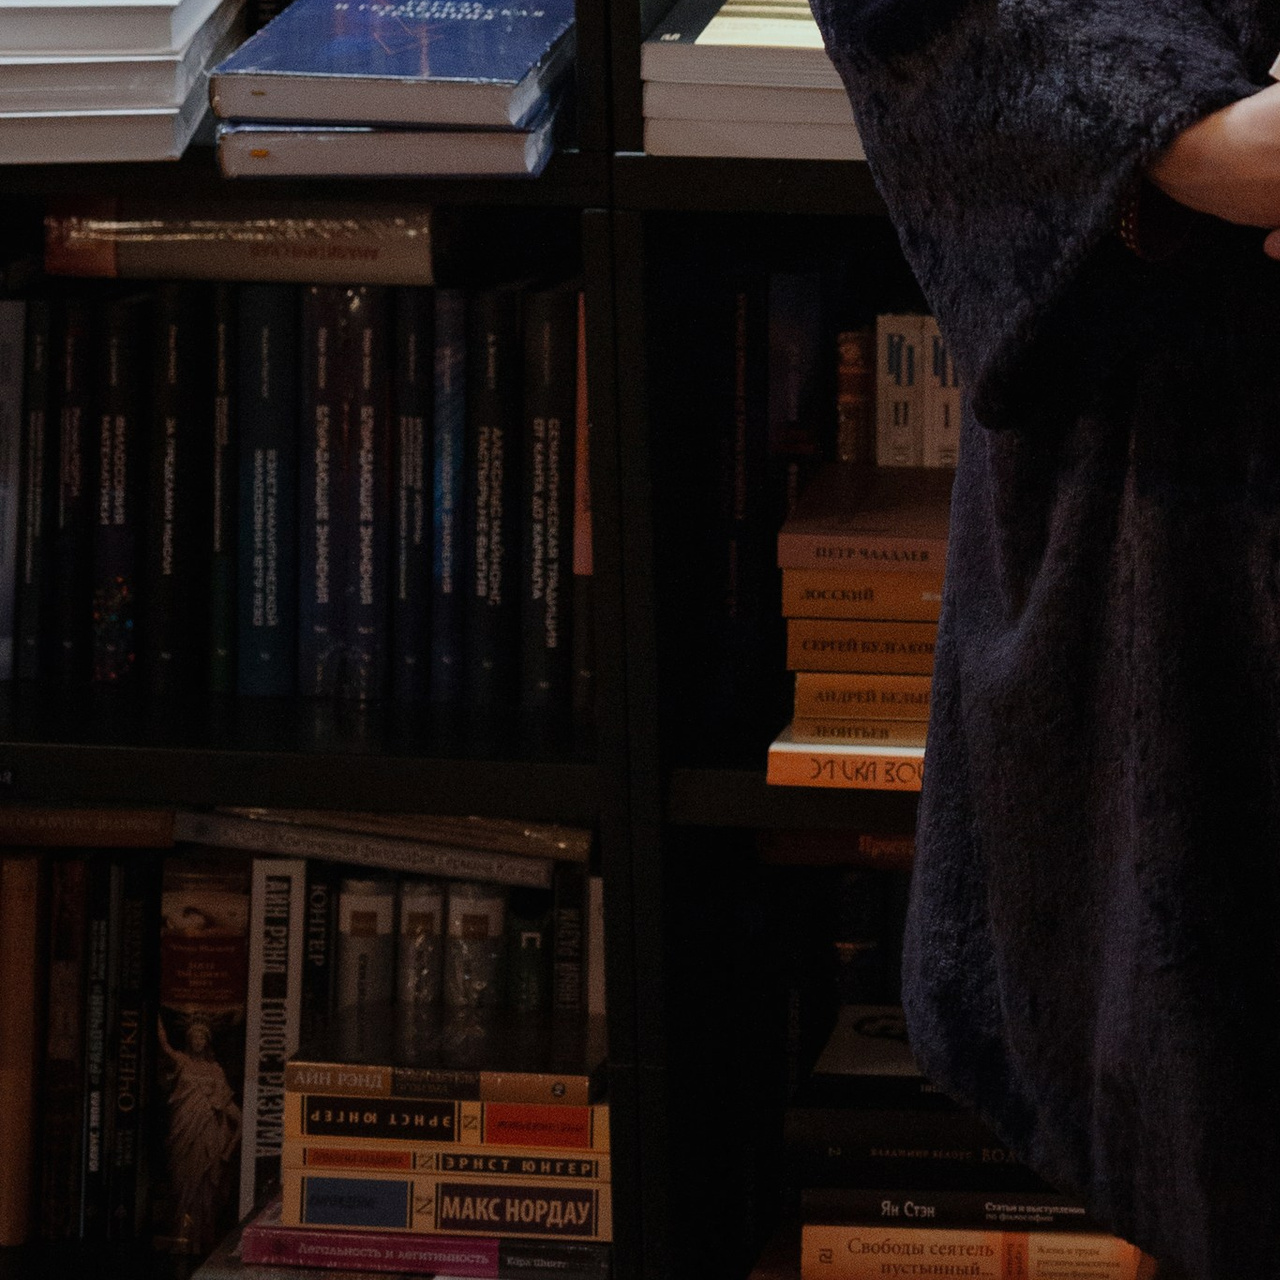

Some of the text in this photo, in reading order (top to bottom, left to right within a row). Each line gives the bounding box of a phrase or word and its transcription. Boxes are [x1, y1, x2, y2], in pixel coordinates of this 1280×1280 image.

[117, 1008, 140, 1112] ОЧЕРКИ
[445, 1157, 591, 1174] ЭРНСТ ЮНГЕР
[442, 1195, 590, 1226] МАКС НОРДАУ
[881, 1200, 935, 1217] Ян Стэн
[848, 1238, 994, 1257] Свободы сеятель
